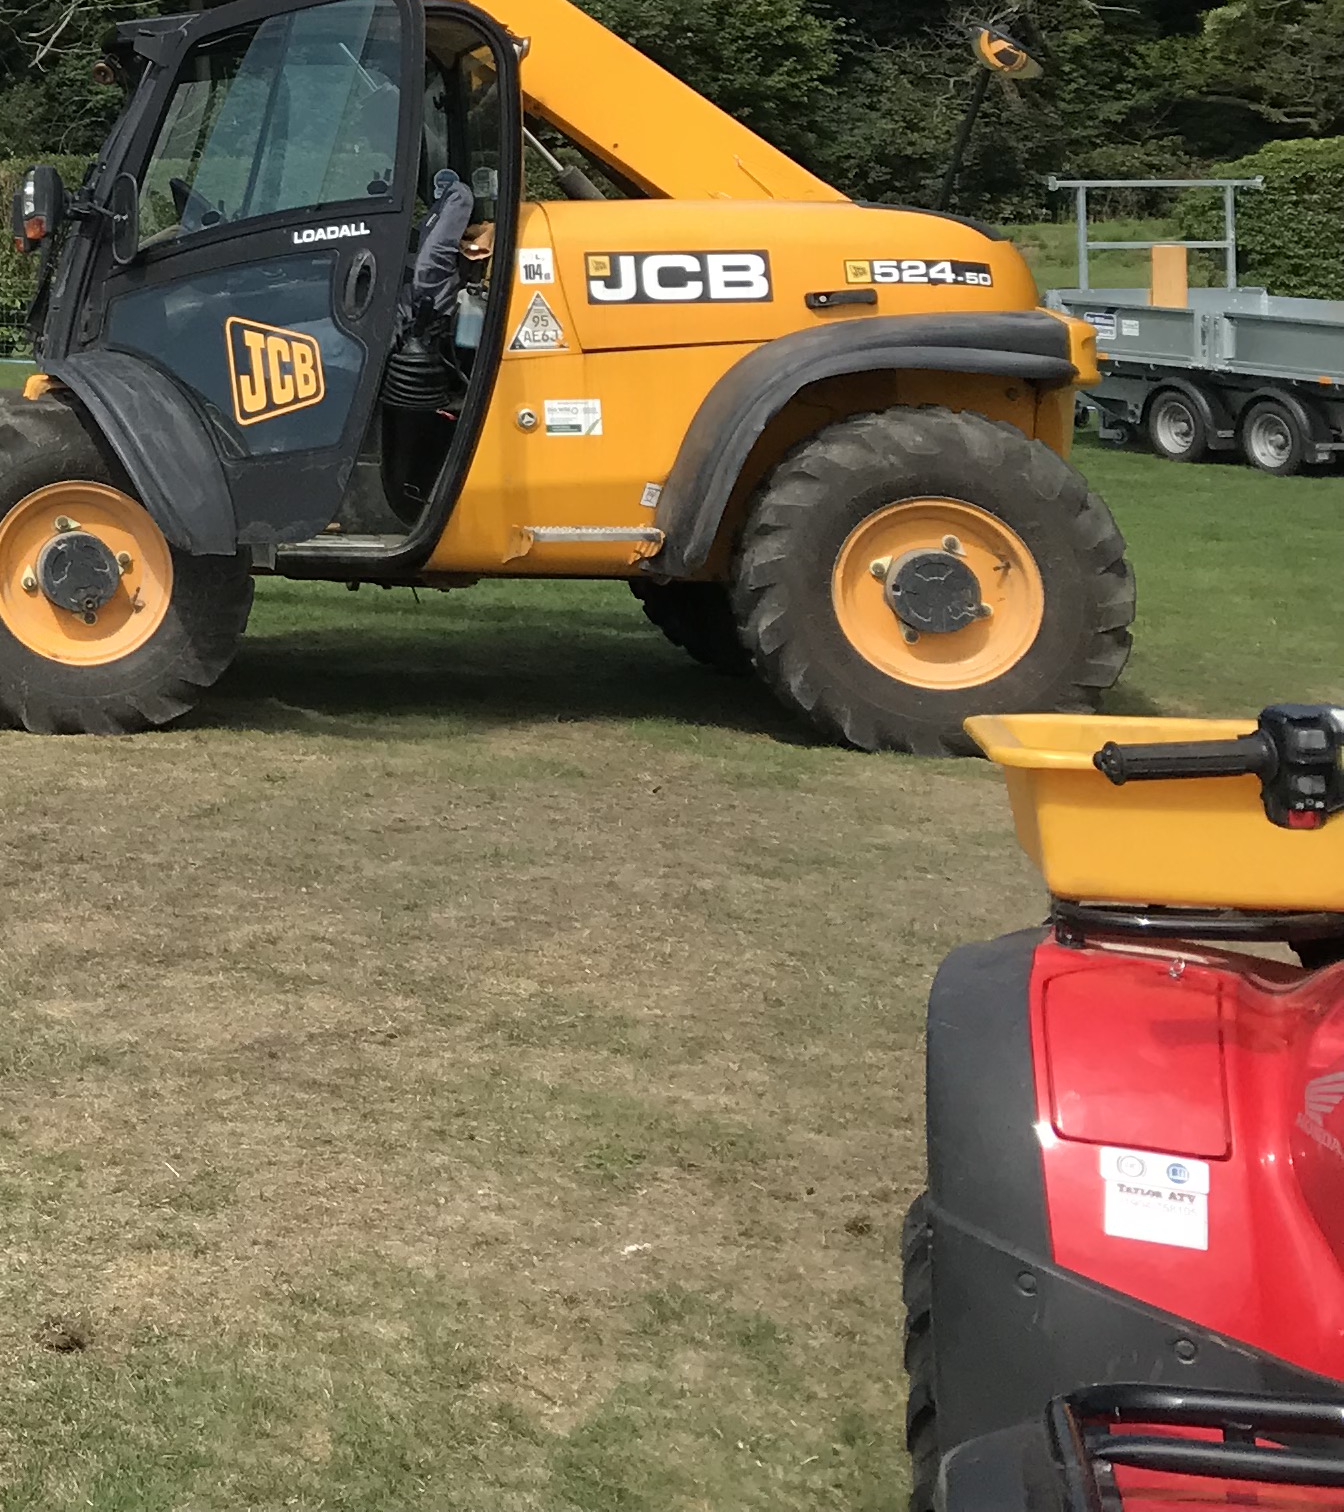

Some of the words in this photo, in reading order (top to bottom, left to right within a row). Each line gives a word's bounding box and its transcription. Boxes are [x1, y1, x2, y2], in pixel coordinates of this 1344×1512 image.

[293, 222, 371, 245] LOADALL
[523, 264, 543, 281] 104
[589, 254, 769, 301] JCB
[873, 260, 991, 286] 524-50
[531, 314, 550, 328] 95
[239, 329, 317, 413] JCB
[1168, 1191, 1196, 1204] ATV
